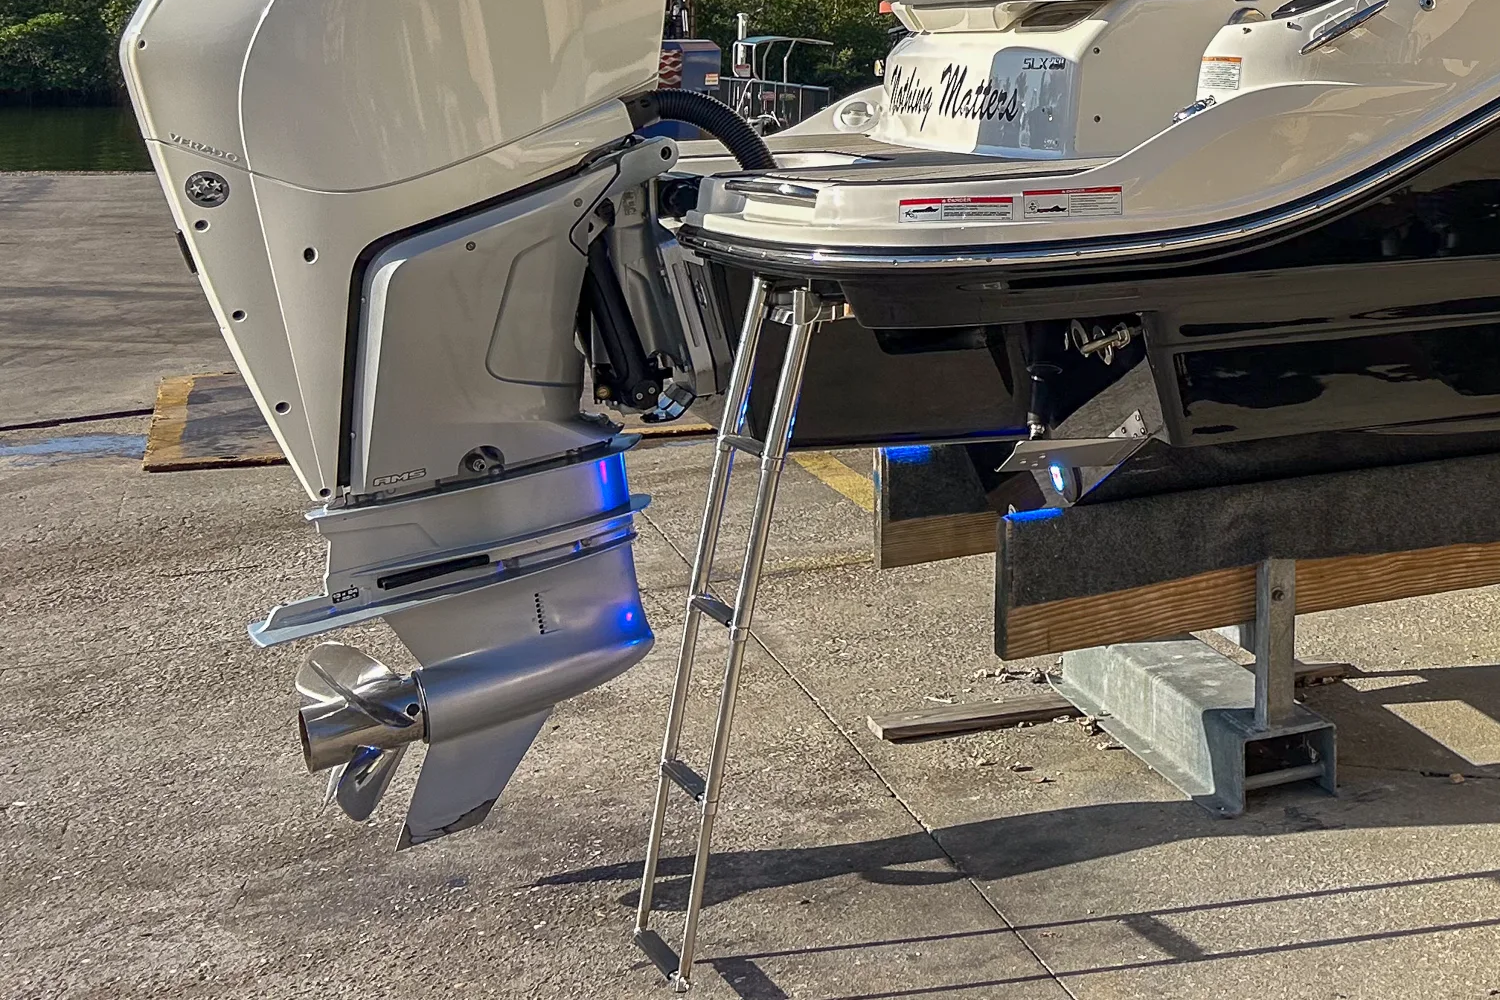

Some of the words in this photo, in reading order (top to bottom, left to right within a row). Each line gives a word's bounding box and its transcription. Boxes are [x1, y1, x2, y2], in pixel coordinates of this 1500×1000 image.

[1021, 57, 1048, 70] SLX
[889, 64, 933, 132] Nothing
[939, 62, 1019, 122] Matters
[168, 132, 240, 163] VERADO
[372, 467, 427, 487] AMS
